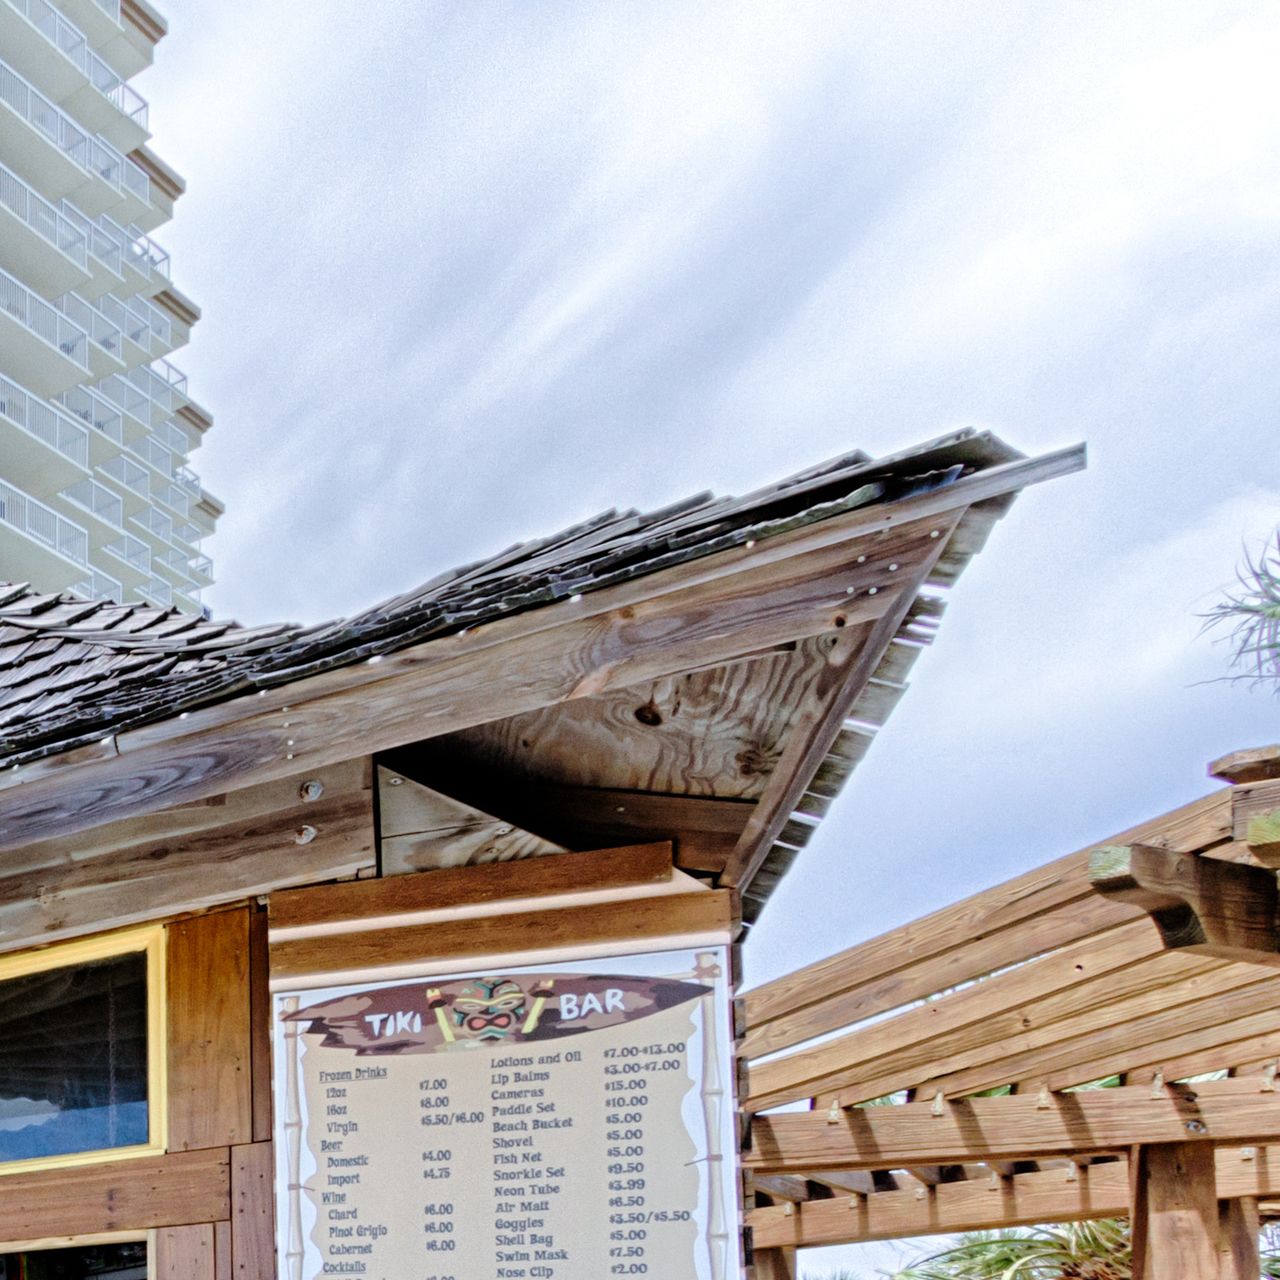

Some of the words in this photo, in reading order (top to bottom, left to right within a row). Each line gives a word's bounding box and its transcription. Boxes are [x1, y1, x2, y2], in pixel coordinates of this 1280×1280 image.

[365, 1012, 422, 1037] TIKI
[559, 988, 626, 1021] BAR
[491, 1056, 533, 1068] Lotions
[538, 1053, 560, 1064] and
[565, 1051, 581, 1062] Oil
[319, 1070, 352, 1083] Frozen
[355, 1066, 387, 1079] Drinks
[491, 1074, 509, 1086] Lip
[514, 1071, 550, 1083] Balms
[326, 1088, 347, 1098] 12oz
[419, 1079, 447, 1090] $7.00
[491, 1087, 544, 1100] Cameras
[605, 1079, 647, 1091] $15.00
[326, 1105, 347, 1115] 16oz
[420, 1097, 449, 1108] $8.00
[492, 1104, 532, 1116] Paddle
[537, 1102, 555, 1113] Set
[605, 1095, 648, 1108] $10.00
[327, 1121, 358, 1136] Virgin
[493, 1120, 528, 1133] Beach
[532, 1118, 573, 1130] Bucket
[606, 1112, 642, 1124] $5.00
[321, 1140, 343, 1151] Beer
[493, 1136, 533, 1149] Shovel
[607, 1129, 643, 1141] $5.00
[327, 1155, 369, 1168] Domestic
[422, 1150, 451, 1161] $4.00
[494, 1153, 518, 1165] Fish
[522, 1152, 542, 1163] Net
[607, 1146, 643, 1158] $5.00
[328, 1173, 360, 1187] Import
[423, 1167, 450, 1179] $4.75
[546, 1167, 565, 1178] Set
[608, 1162, 644, 1174] $9.50
[494, 1186, 525, 1197] Neon
[529, 1184, 560, 1195] Tube
[609, 1179, 645, 1191] $3.99
[322, 1192, 346, 1203] Wine
[495, 1202, 516, 1213] Air
[609, 1196, 645, 1207] $6.50
[328, 1208, 358, 1220] Chard
[424, 1204, 453, 1215] $6.00
[329, 1226, 353, 1238] Pinot
[356, 1225, 388, 1240] Grigio
[424, 1222, 453, 1233] $6.00
[495, 1217, 544, 1232] Goggles
[495, 1234, 525, 1246] Shell
[530, 1233, 553, 1247] Bag
[610, 1229, 647, 1240] $5.00
[329, 1244, 373, 1255] Cabernet
[426, 1240, 455, 1251] $6.00
[495, 1250, 530, 1262] Swim
[534, 1249, 569, 1261] Mask
[609, 1246, 644, 1258] $7.50
[323, 1261, 366, 1273] Cocktails
[496, 1267, 526, 1278] Nose
[530, 1266, 553, 1279] Clip
[611, 1263, 648, 1274] $2.00
